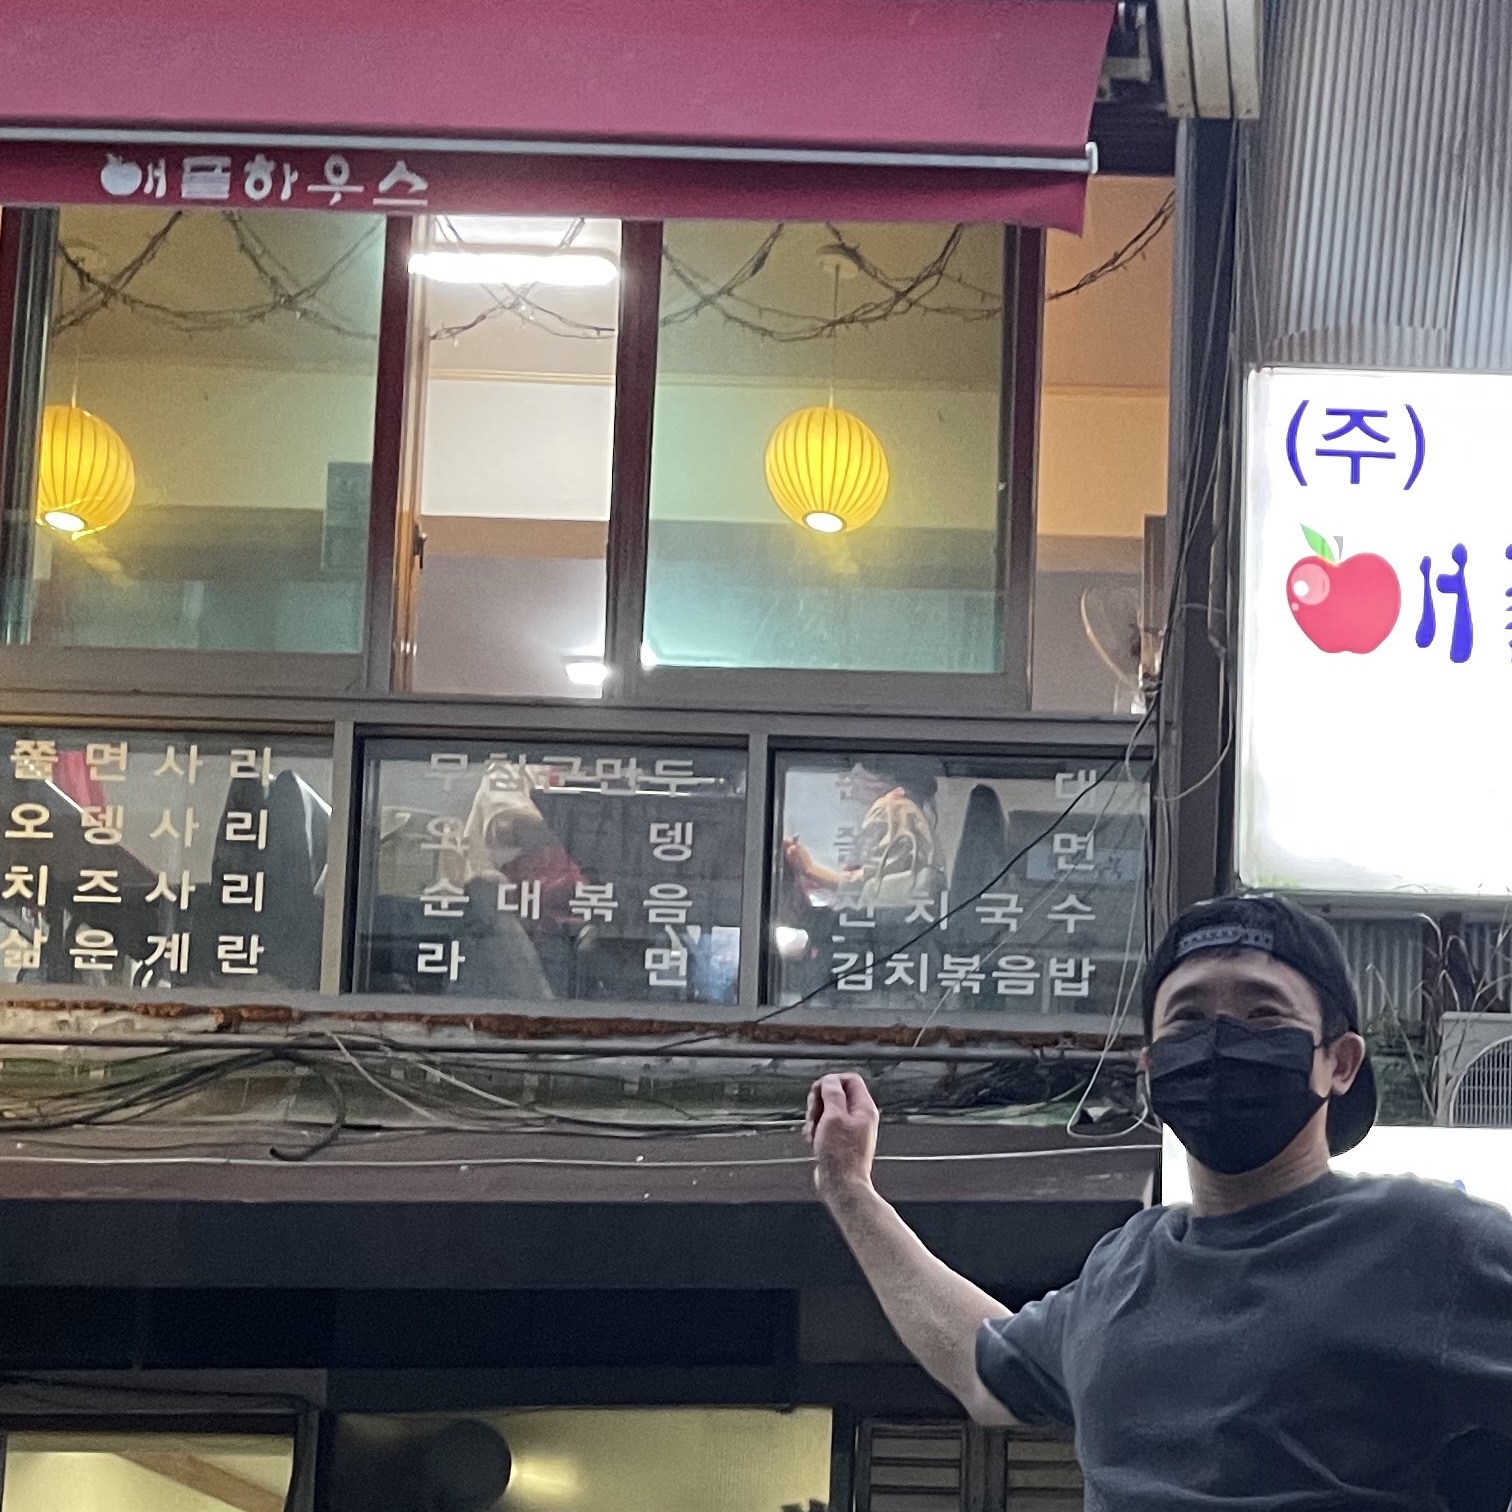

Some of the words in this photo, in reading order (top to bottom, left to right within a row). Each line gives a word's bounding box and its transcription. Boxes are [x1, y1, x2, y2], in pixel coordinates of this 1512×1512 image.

[1285, 399, 1427, 490] (주)
[4, 803, 268, 850] 오뎅사리
[1, 865, 265, 912] 치즈사리
[830, 951, 1096, 998] 김치볶음밥
